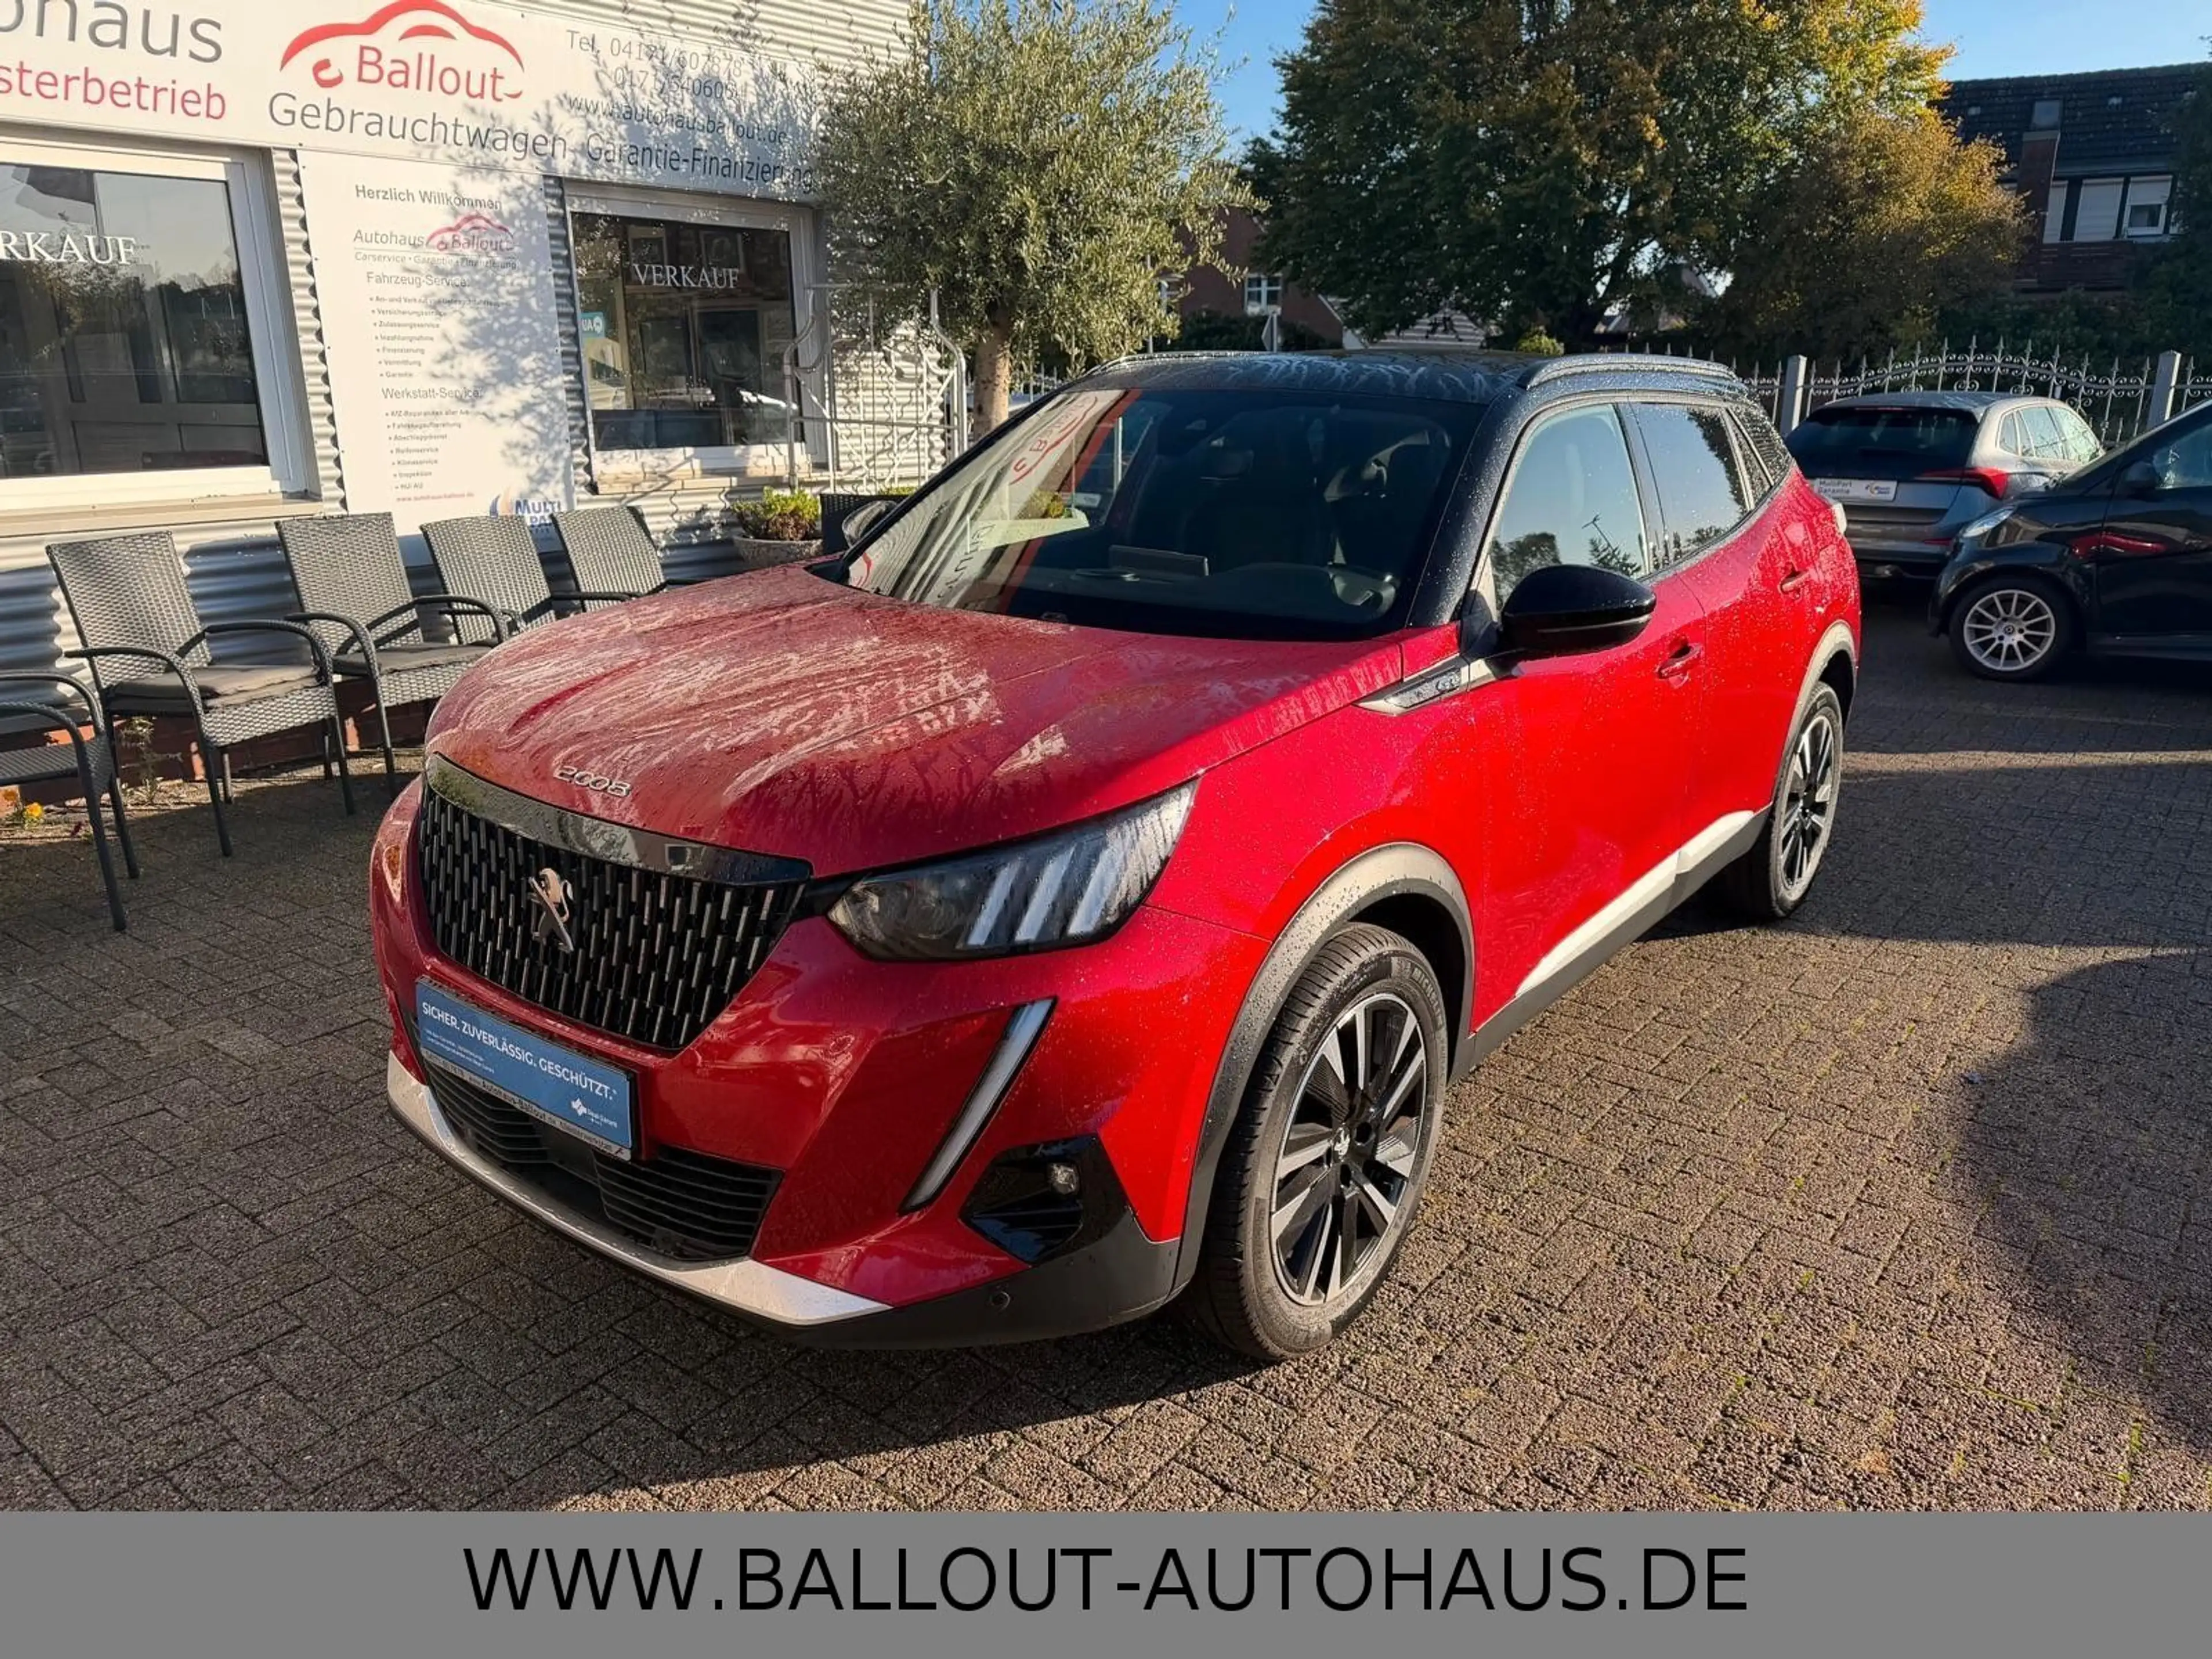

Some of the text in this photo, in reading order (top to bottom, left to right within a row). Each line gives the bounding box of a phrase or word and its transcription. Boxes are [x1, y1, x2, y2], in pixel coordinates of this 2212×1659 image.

[357, 45, 503, 103] Ballout
[269, 92, 567, 161] Gebrauchtwagen
[355, 184, 502, 211] Herzlich Willkommen
[0, 230, 135, 265] RKAUF
[353, 229, 509, 251] Autohaus Ballout
[634, 263, 740, 289] VERKAUF
[515, 498, 561, 514] MULTI
[554, 766, 631, 798] 2008
[1411, 965, 1445, 1030] MICHELIN
[422, 1002, 460, 1031] SICHER.
[461, 1020, 537, 1069] ZUVERLÄSSIG.
